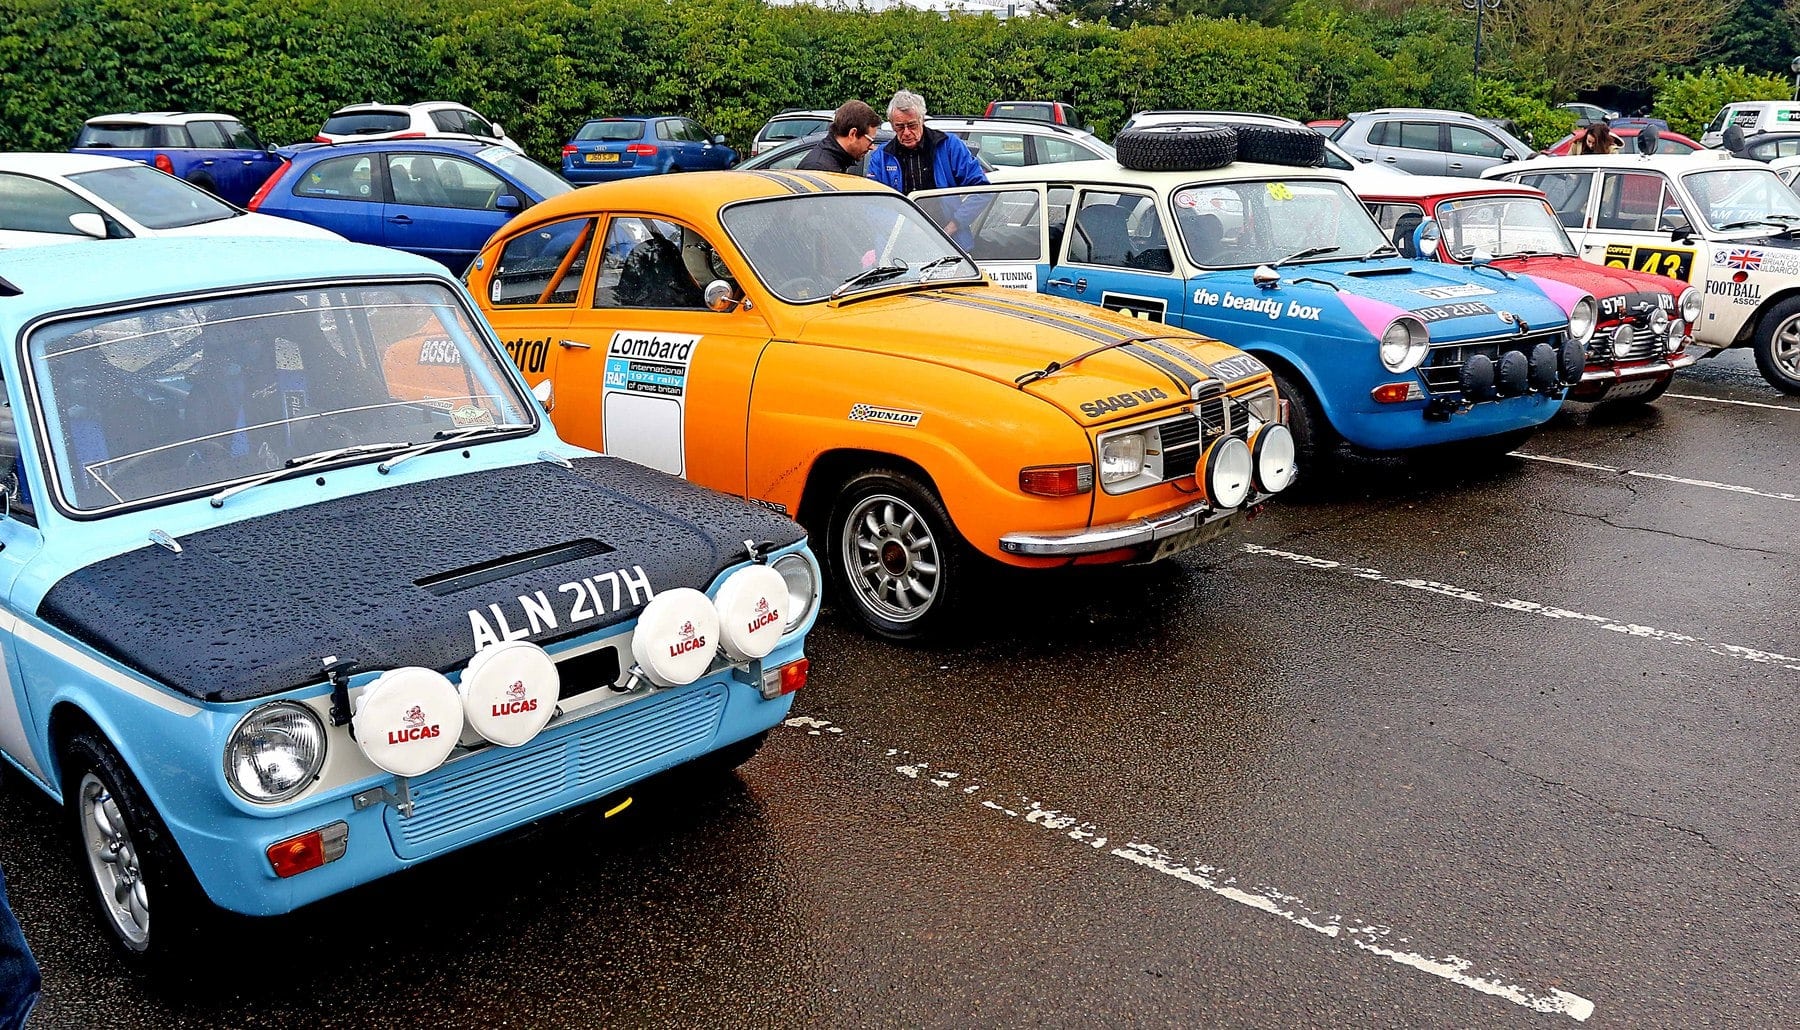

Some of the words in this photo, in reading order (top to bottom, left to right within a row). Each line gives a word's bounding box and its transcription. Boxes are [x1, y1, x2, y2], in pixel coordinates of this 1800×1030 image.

[1000, 272, 1033, 281] TUNING
[1704, 280, 1761, 299] FOOTBALL
[1193, 288, 1218, 306] the
[1222, 291, 1284, 320] beauty
[1286, 300, 1323, 321] box
[610, 333, 694, 361] Lombard
[630, 362, 684, 375] international
[606, 372, 625, 386] RAC
[629, 373, 655, 381] 1974
[656, 376, 681, 386] rally
[637, 383, 657, 392] great
[658, 385, 681, 394] britain
[1080, 392, 1140, 418] SAAB
[1137, 387, 1168, 403] V4
[868, 410, 918, 423] DUNLOP
[468, 591, 558, 653] ALN
[558, 565, 654, 623] 217H
[748, 609, 779, 633] LUCAS
[670, 635, 706, 657] LUCAS
[492, 698, 537, 717] LUCAS
[388, 724, 440, 744] LUCAS
